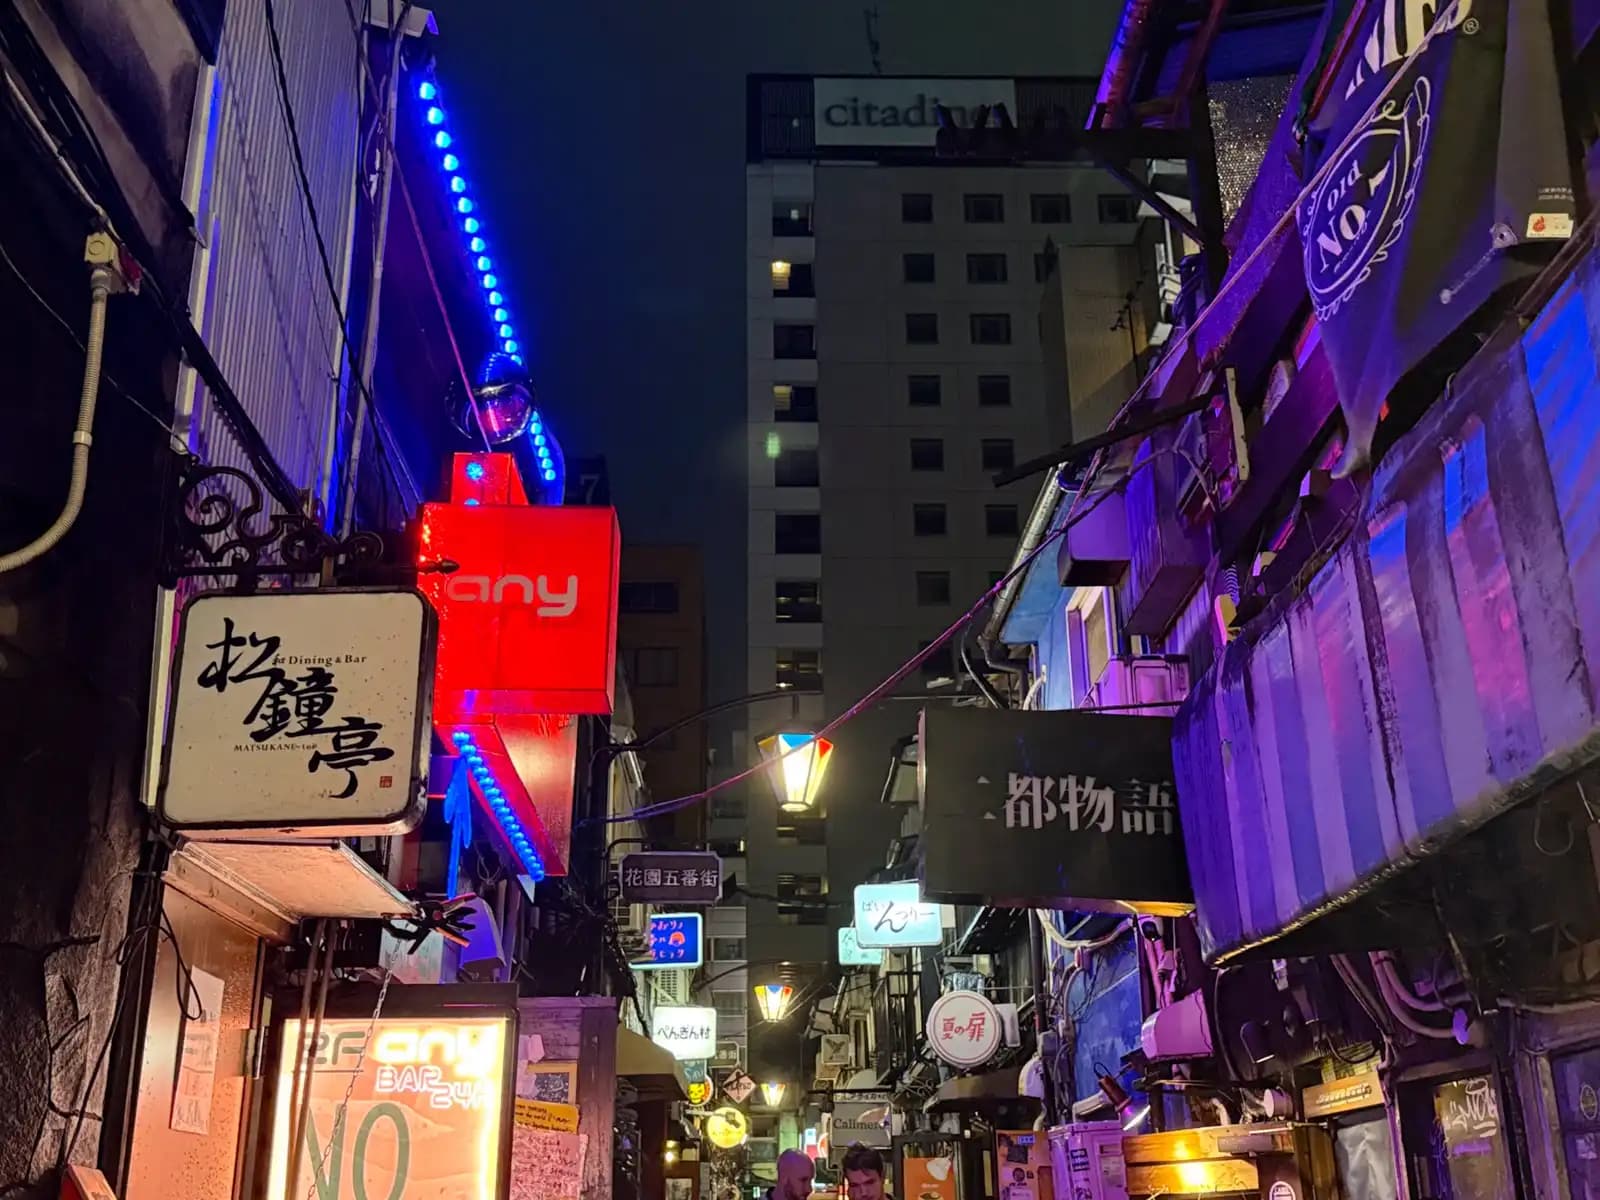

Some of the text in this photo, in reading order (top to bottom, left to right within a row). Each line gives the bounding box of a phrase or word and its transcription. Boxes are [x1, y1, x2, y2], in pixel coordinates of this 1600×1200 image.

[448, 573, 578, 617] any
[289, 655, 332, 667] Dining
[345, 654, 366, 663] Bar
[625, 868, 718, 887] 花園五番街
[657, 1024, 712, 1040] ぺんぎん村
[942, 1011, 986, 1042] 夏の扉
[303, 1031, 366, 1065] 2F
[376, 1028, 497, 1078] any
[376, 1065, 442, 1093] BAR
